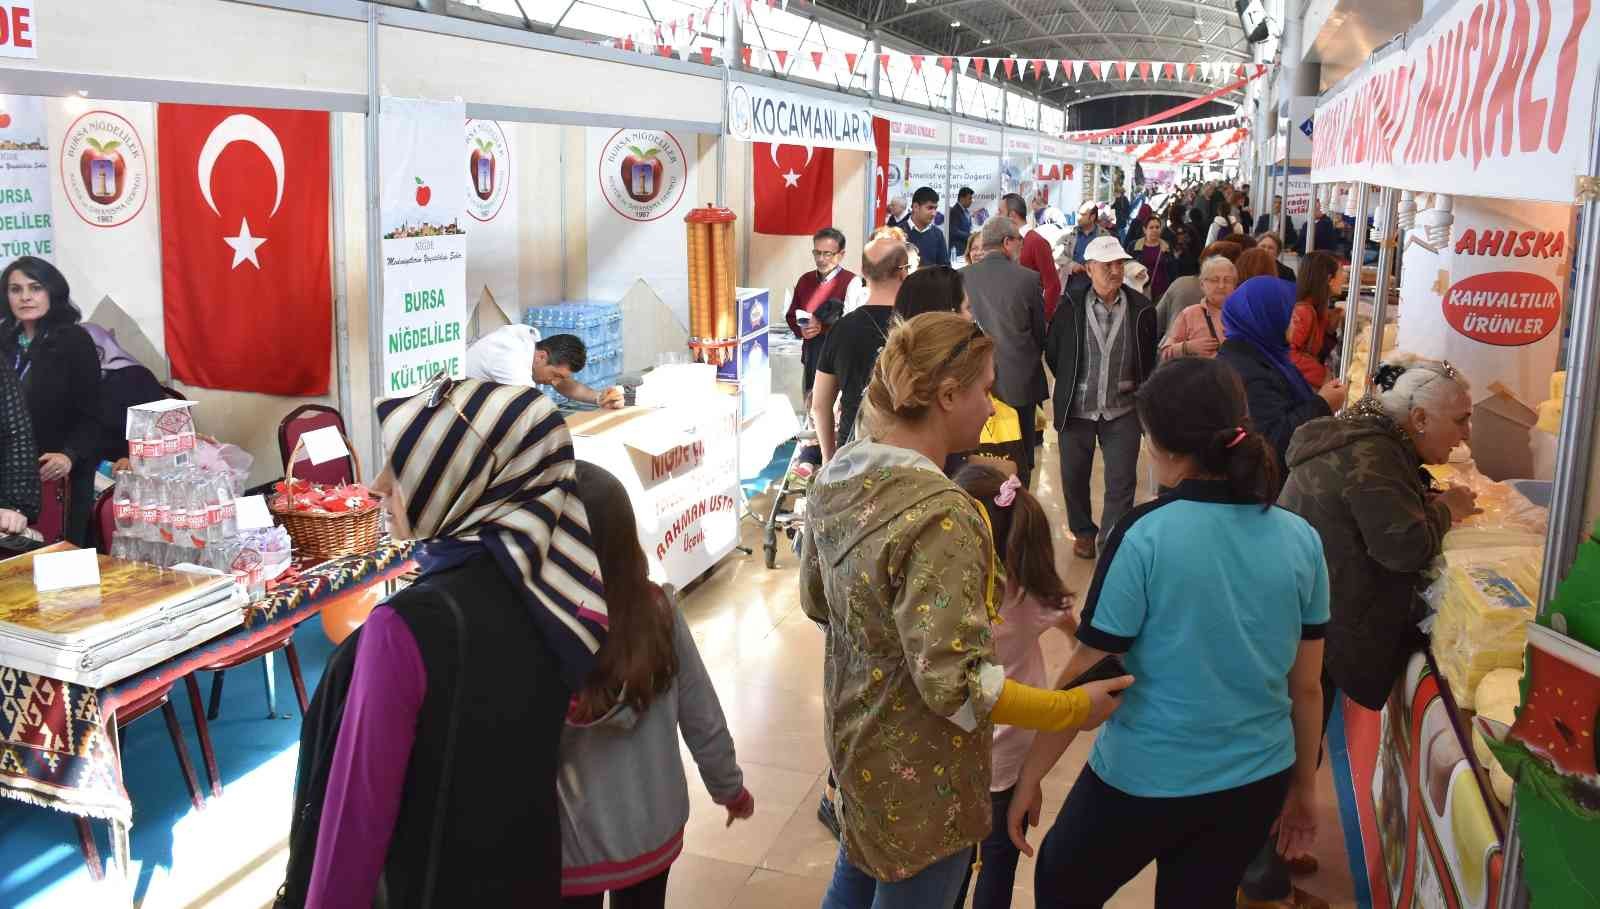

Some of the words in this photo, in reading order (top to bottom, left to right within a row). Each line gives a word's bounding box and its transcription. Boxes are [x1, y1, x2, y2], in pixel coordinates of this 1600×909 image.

[752, 96, 860, 143] KOCAMANLAR
[0, 240, 31, 257] TÜR
[34, 240, 52, 255] VE
[1455, 228, 1565, 259] AHISKA
[404, 288, 446, 313] BURSA
[1449, 289, 1557, 309] KAHVALTILIK
[388, 320, 461, 354] NİĞDELİLER
[1463, 312, 1544, 335] ÜRÜNLER
[391, 358, 444, 392] KÜLTÜR
[444, 356, 459, 377] VE
